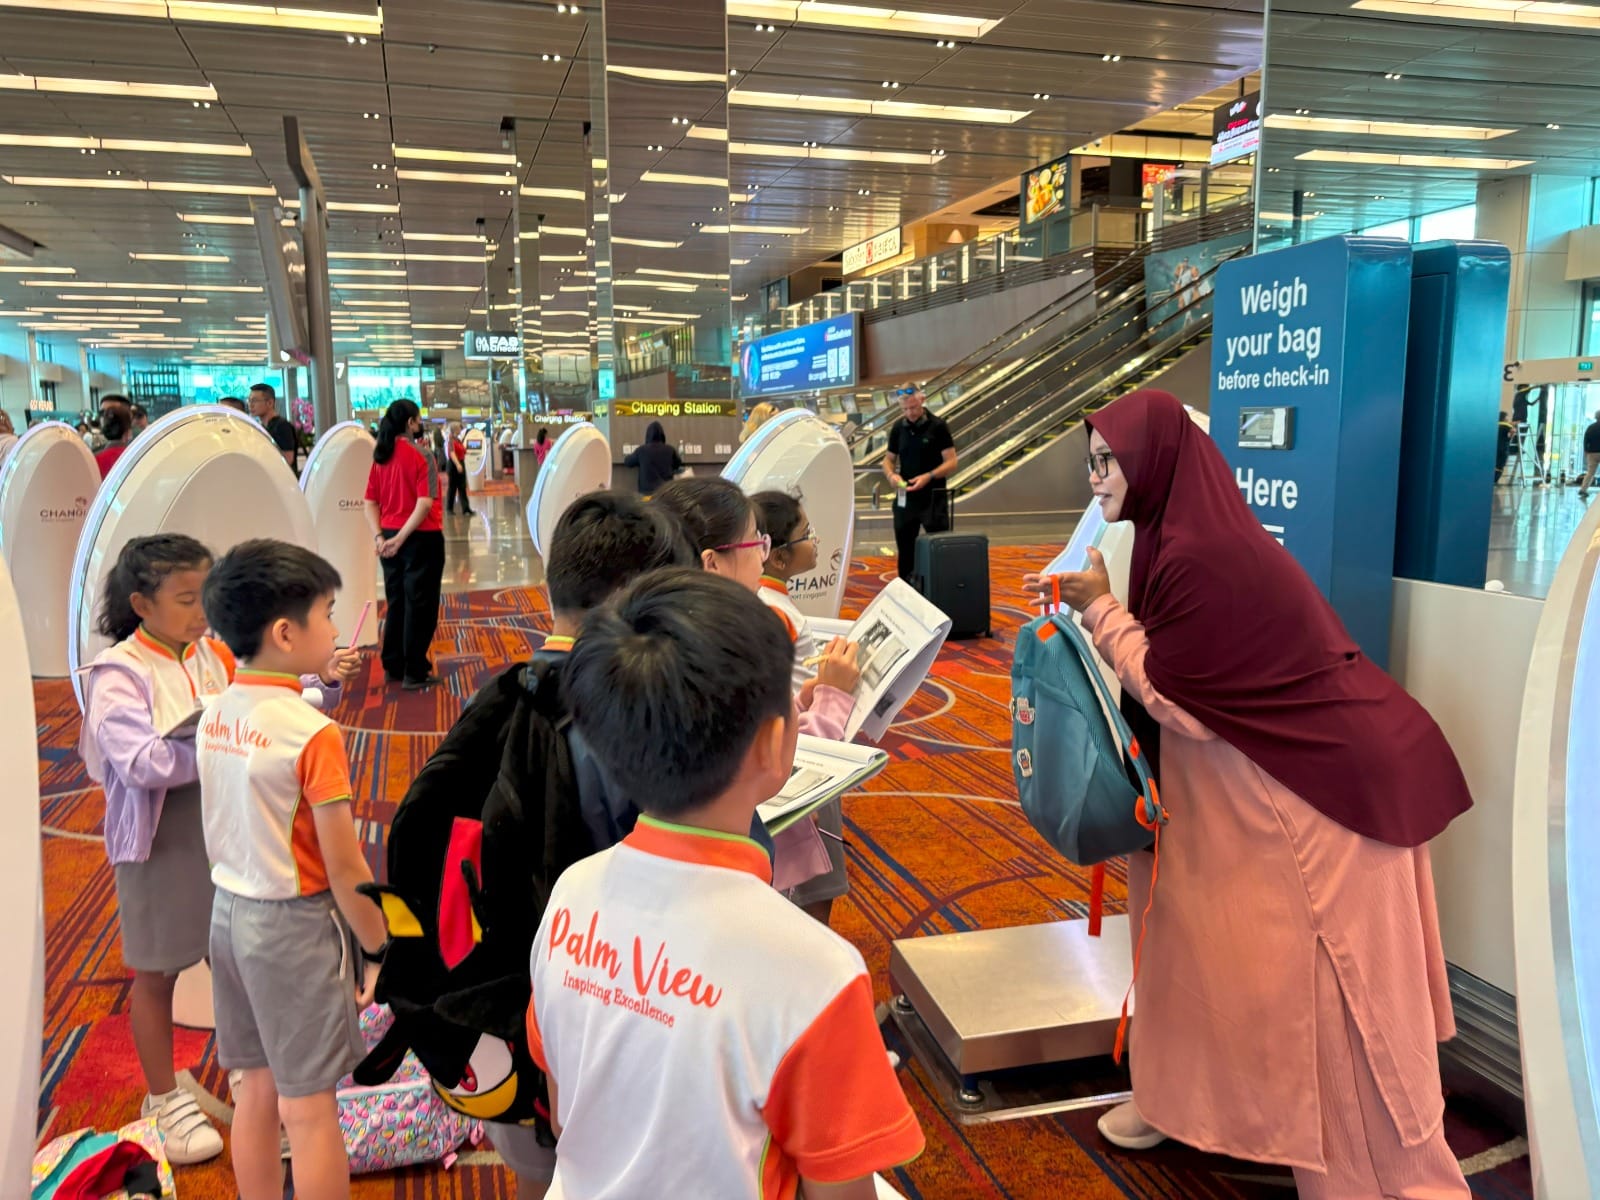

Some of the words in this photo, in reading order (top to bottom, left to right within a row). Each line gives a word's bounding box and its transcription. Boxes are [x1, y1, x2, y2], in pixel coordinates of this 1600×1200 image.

[1240, 276, 1308, 317] Weigh
[1226, 331, 1272, 366] your
[1278, 323, 1321, 359] bag
[335, 362, 345, 379] 7
[1218, 369, 1261, 390] before
[1263, 364, 1330, 388] check-in
[534, 415, 563, 424] Charging
[564, 415, 586, 423] Station
[631, 402, 680, 416] Charging
[684, 402, 721, 414] Station
[1235, 467, 1298, 509] Here
[788, 573, 837, 592] CHANG
[235, 717, 273, 749] View
[548, 907, 623, 981] Palm
[632, 935, 723, 1009] View
[562, 969, 612, 1006] Inspiring
[613, 987, 676, 1029] Excellence
